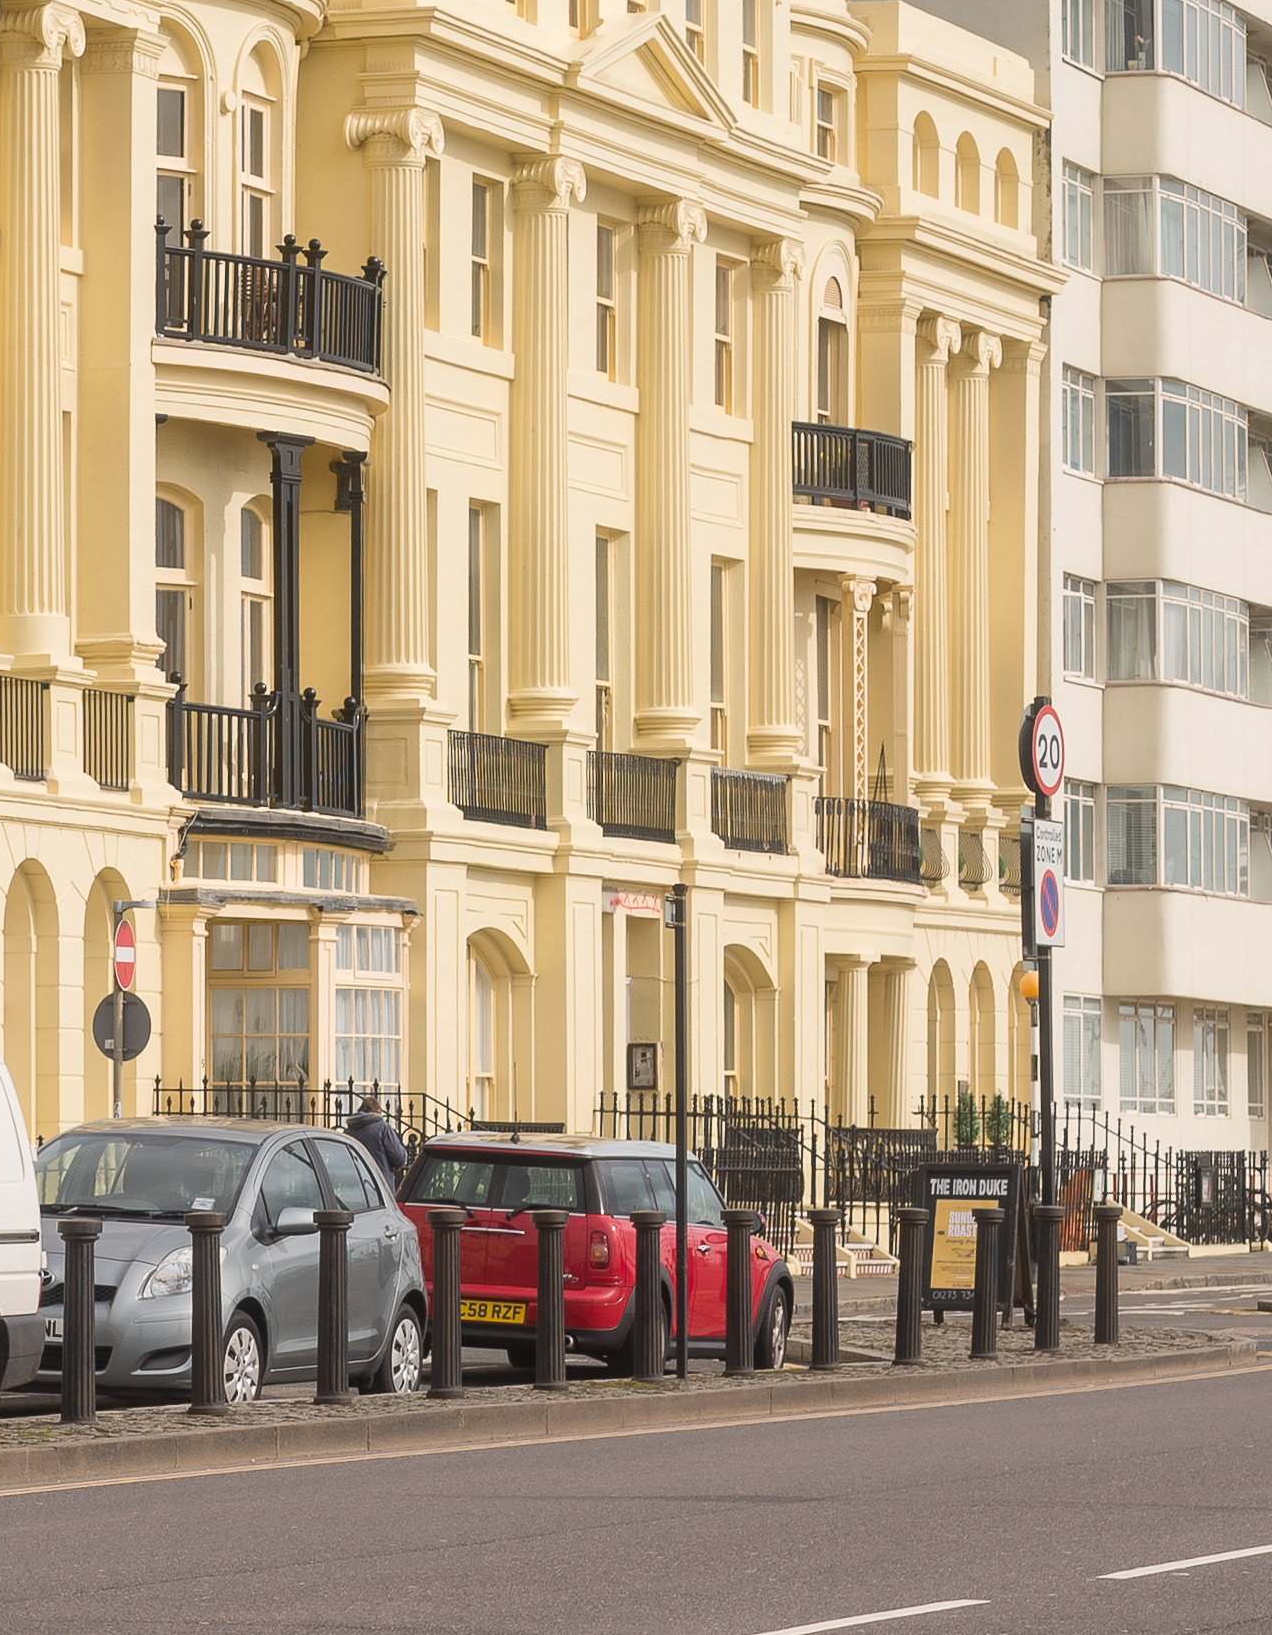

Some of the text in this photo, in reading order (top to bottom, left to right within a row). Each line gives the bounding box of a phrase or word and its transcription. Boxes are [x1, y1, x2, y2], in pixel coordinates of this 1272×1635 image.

[1038, 734, 1060, 770] 20
[1036, 825, 1062, 842] Controlled
[1037, 845, 1055, 864] ZONE
[930, 1178, 1008, 1196] THE IRON DUKE
[492, 1304, 523, 1320] RZF
